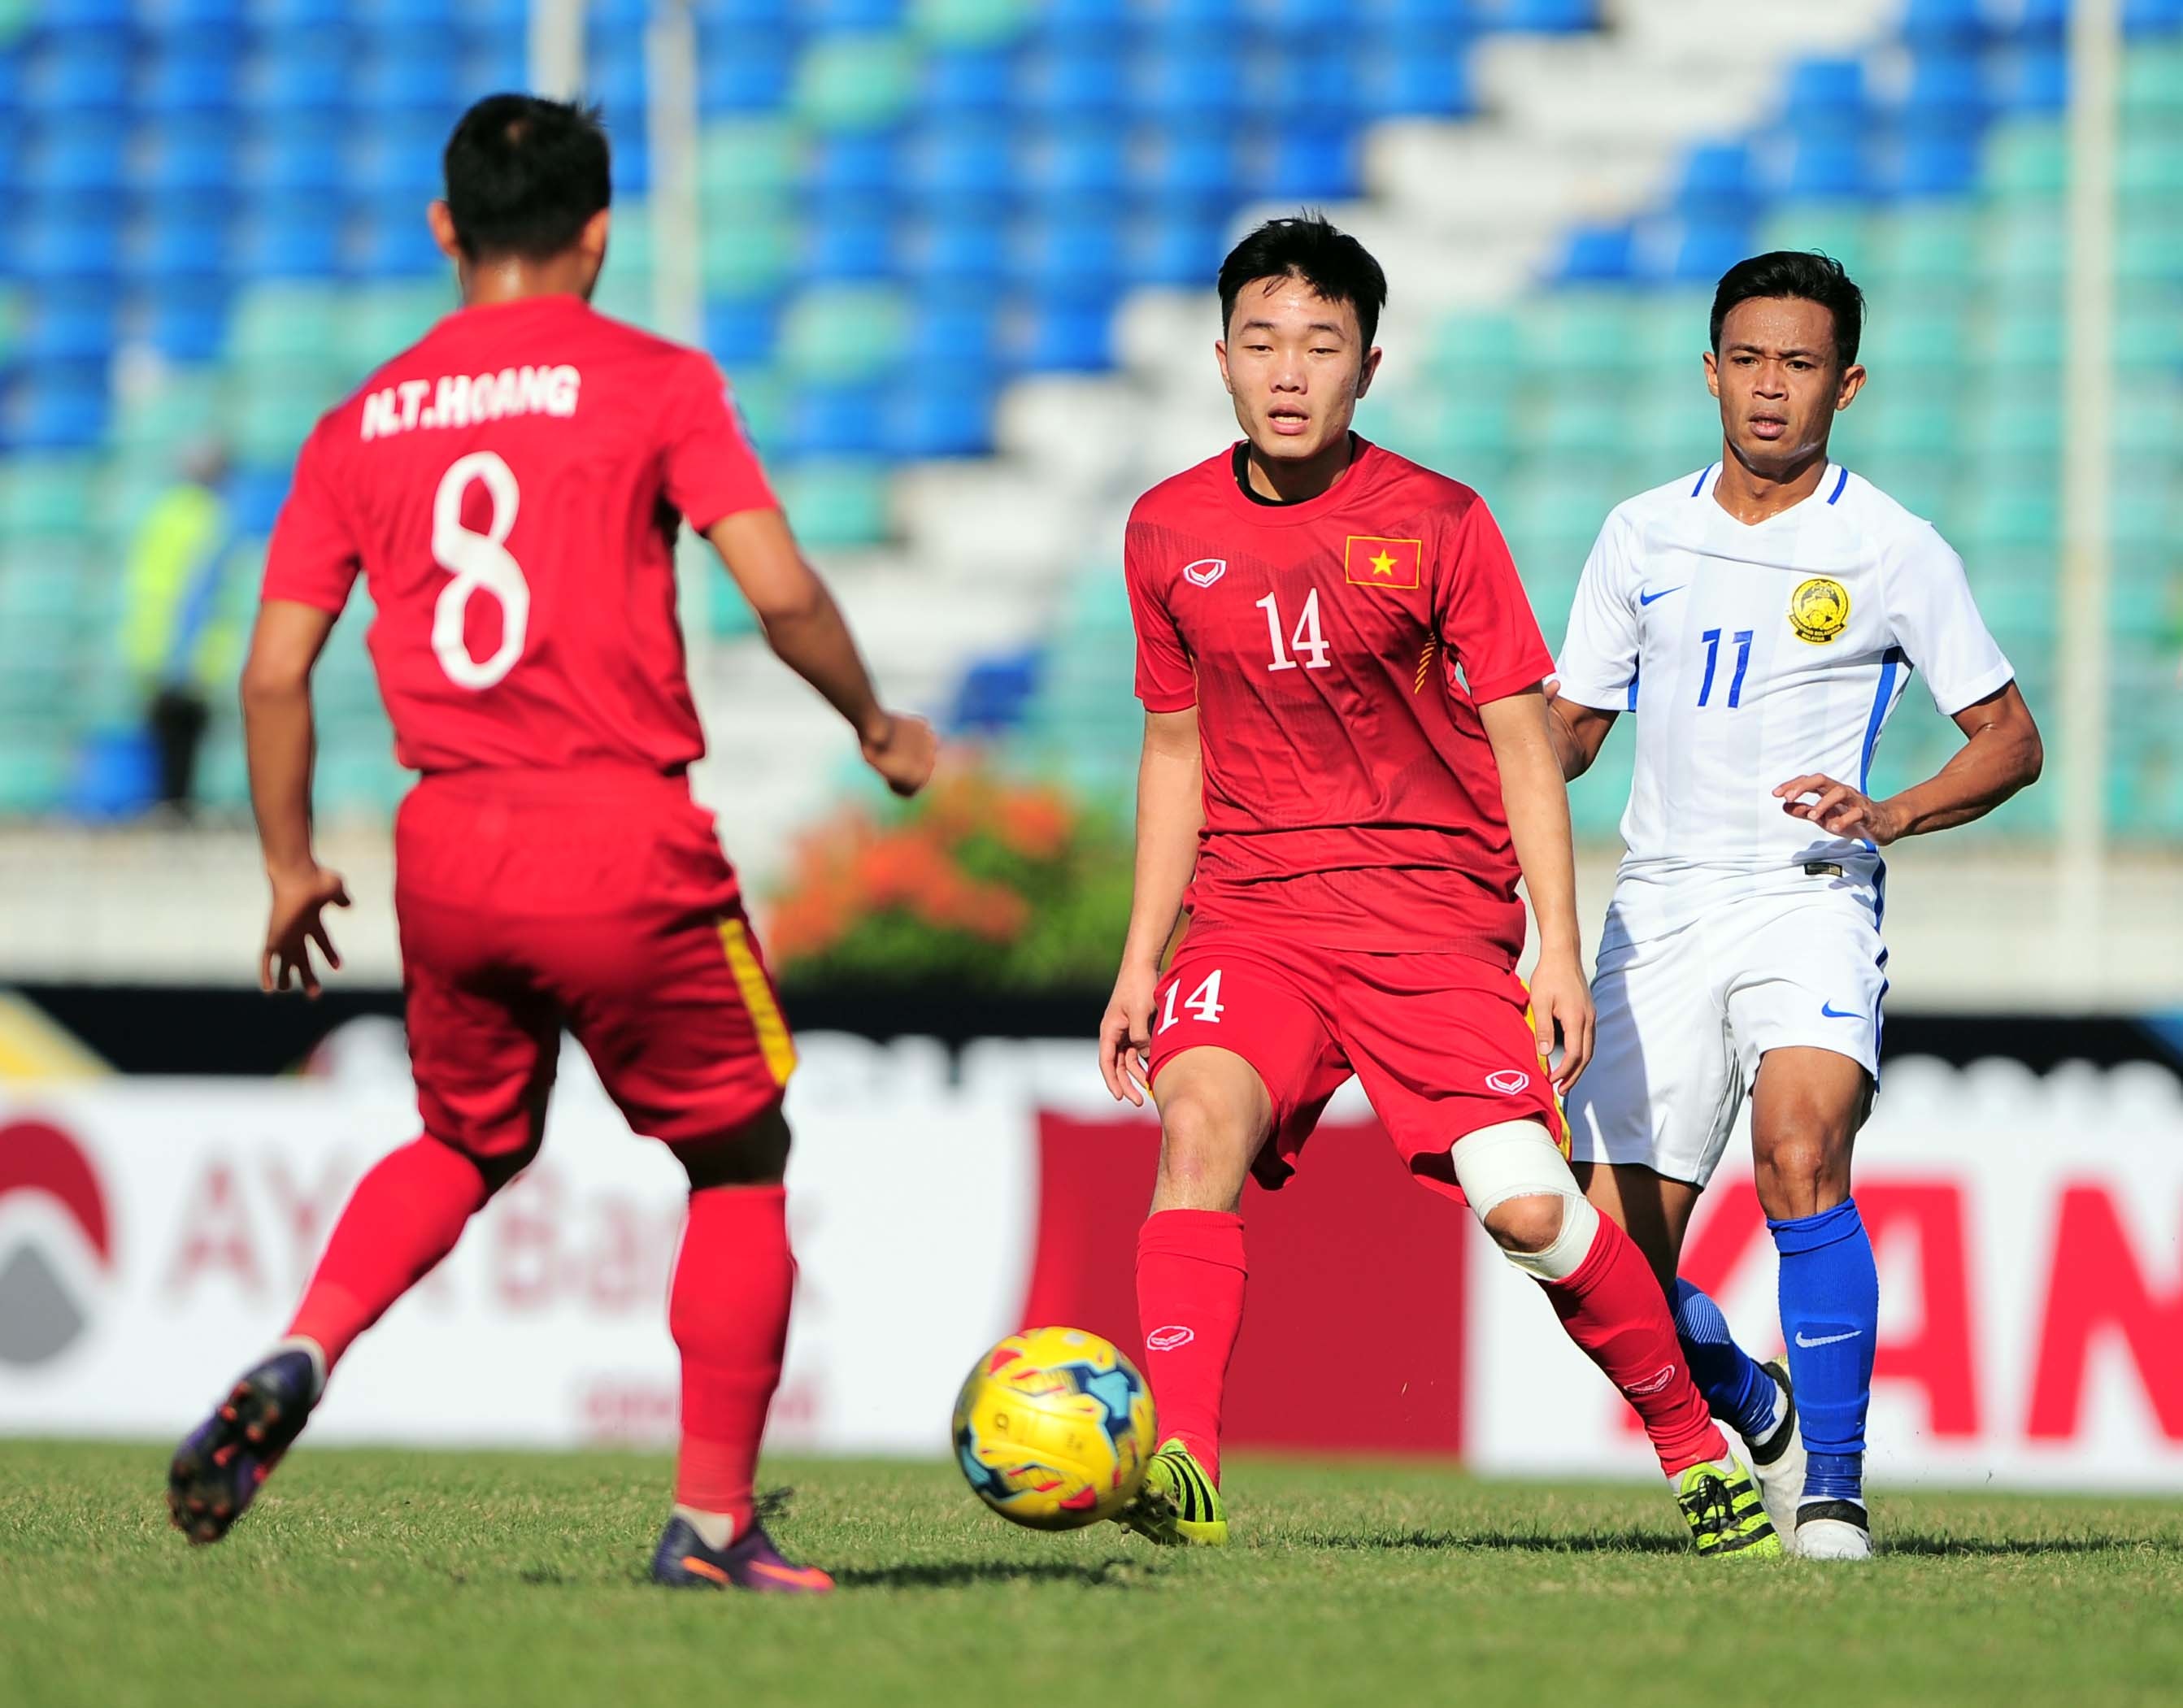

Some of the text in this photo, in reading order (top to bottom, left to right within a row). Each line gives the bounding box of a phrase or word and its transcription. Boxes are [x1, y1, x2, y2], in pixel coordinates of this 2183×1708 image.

[362, 365, 580, 439] N.T.HOANG
[431, 451, 530, 689] 8
[1256, 588, 1330, 671] 14
[1698, 628, 1754, 708] 11
[1157, 969, 1224, 1034] 14
[163, 1158, 820, 1310] AY Ba
